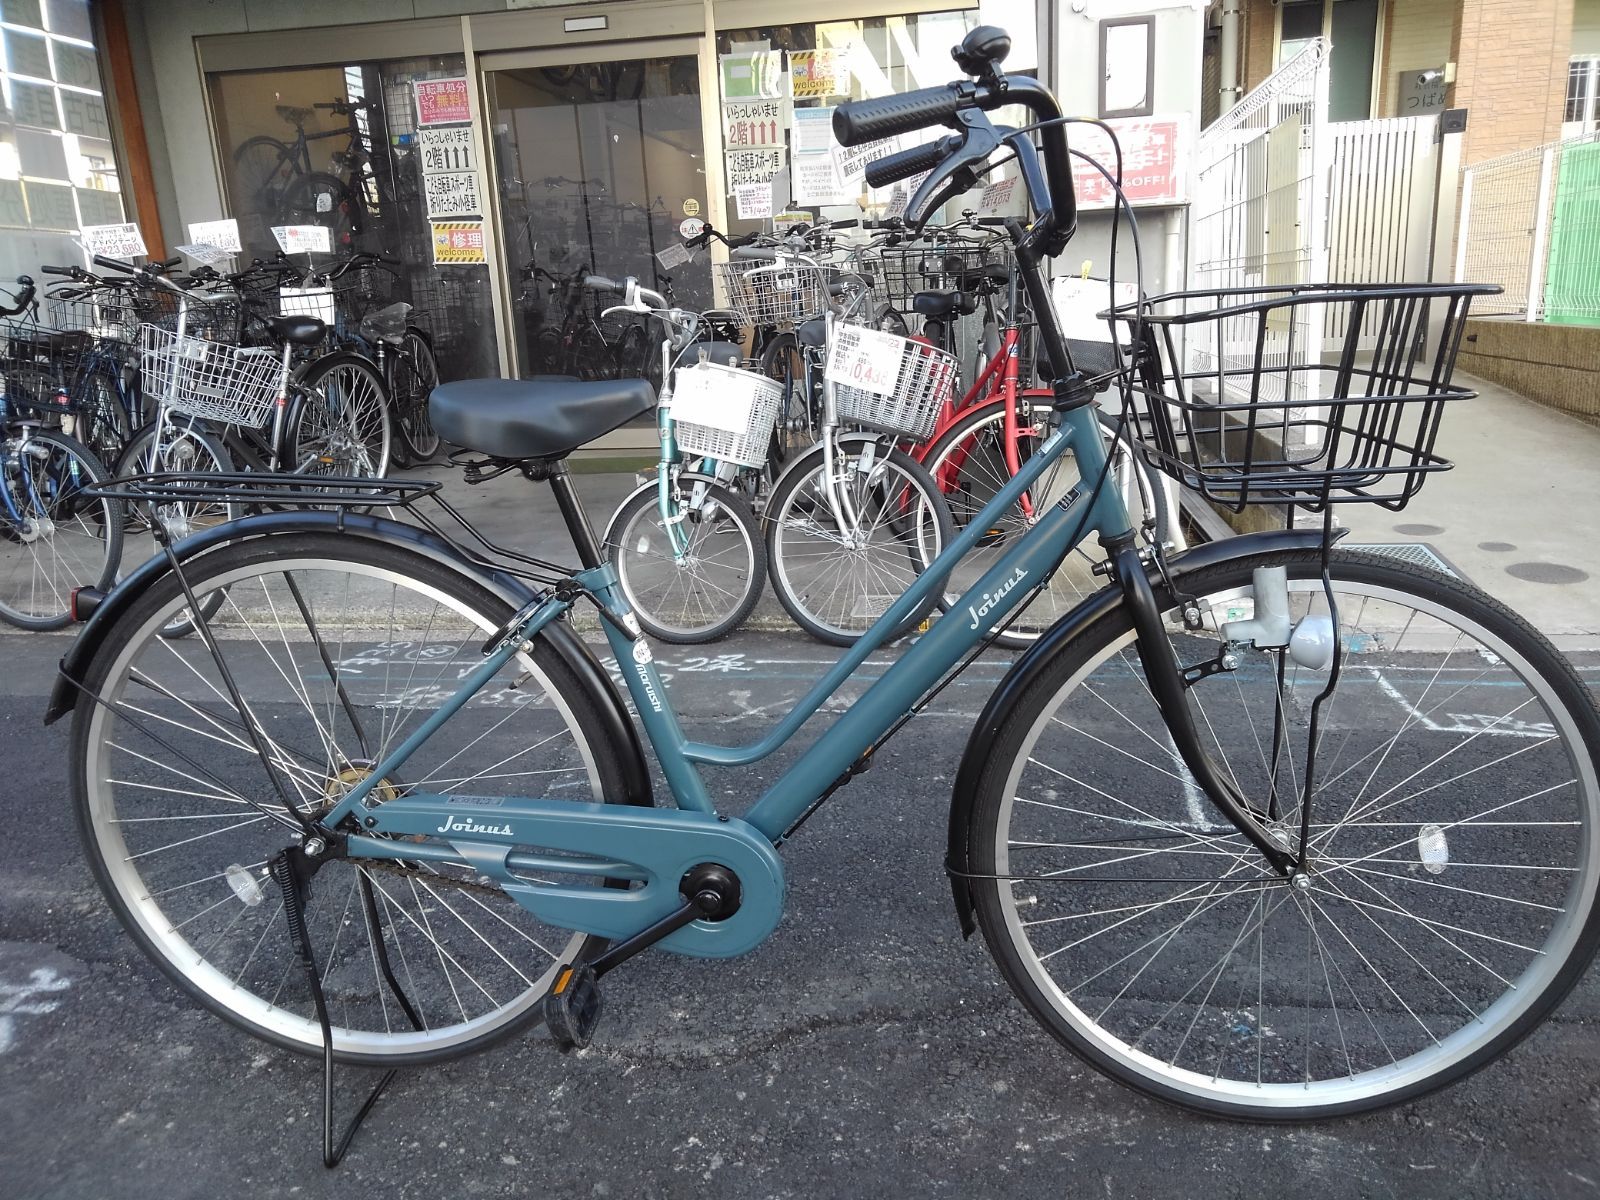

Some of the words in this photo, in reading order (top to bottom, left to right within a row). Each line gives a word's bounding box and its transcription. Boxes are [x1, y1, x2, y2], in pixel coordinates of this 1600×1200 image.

[418, 82, 466, 96] 自転車処分
[727, 102, 779, 119] いらっしゃいませ
[421, 128, 469, 144] いらっしゃいませ
[729, 120, 748, 146] 2階
[425, 145, 443, 170] 2階
[452, 231, 483, 249] 修理
[438, 248, 476, 257] welcome
[968, 567, 1029, 630] Joinus
[635, 663, 663, 713] maruishi
[437, 815, 514, 836] Joinus
